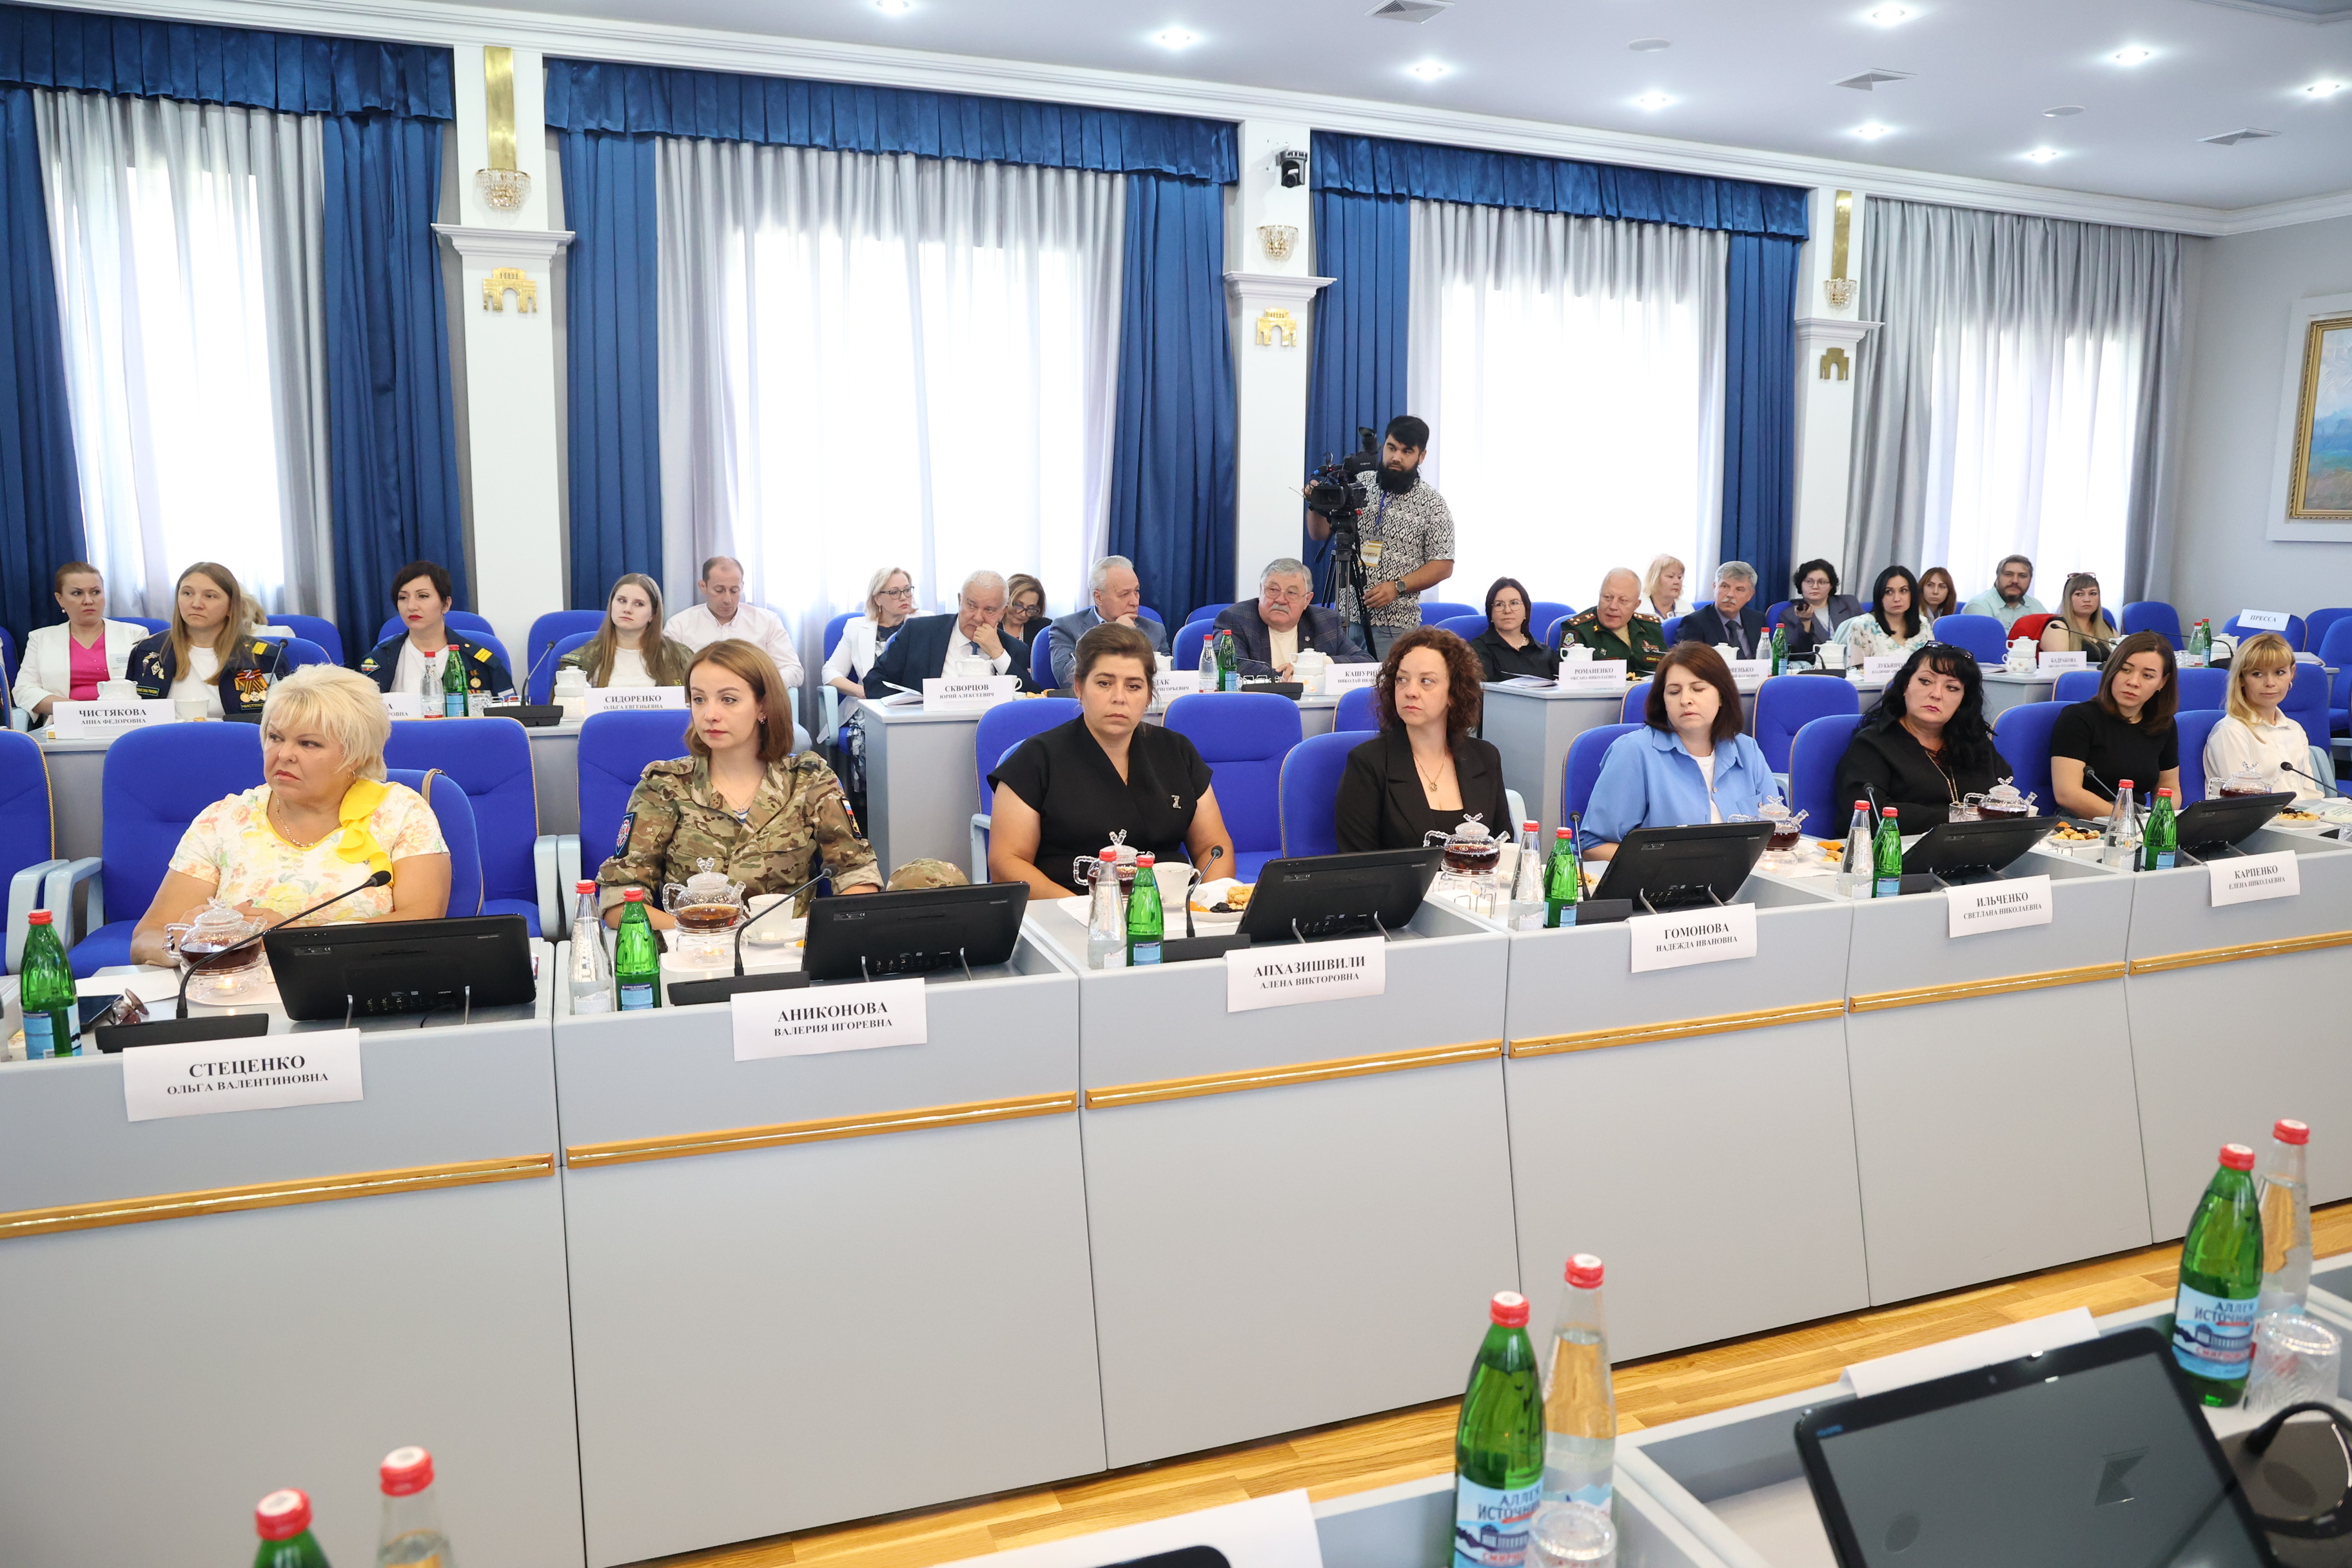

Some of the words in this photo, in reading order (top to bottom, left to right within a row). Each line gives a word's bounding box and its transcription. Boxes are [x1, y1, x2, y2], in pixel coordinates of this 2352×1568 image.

[945, 684, 989, 692] СКВОРЦОВ
[605, 695, 662, 703] СИДОРЕНКО
[79, 709, 147, 717] ЧИСТЯКОВА
[2235, 865, 2278, 879] КАРПЕНКО
[2248, 877, 2286, 887] НИКОЛАЕВНА
[1977, 892, 2028, 907] ИЛЬЧЕНКО
[1963, 910, 1998, 919] СВЕТЛАНА
[1999, 903, 2043, 915] НИКОЛАЕВНА
[1664, 923, 1729, 939] ГОМОНОВА
[1656, 941, 1694, 952] НАДЕЖДА
[1696, 936, 1738, 947] ИВАНОВНА
[1253, 956, 1366, 977] АПХАЗИШВИЛИ
[1260, 980, 1293, 990] АЛЕНА
[1296, 973, 1359, 986] ВИКТОРОВНА
[778, 1001, 888, 1022] АНИКОНОВА
[774, 1024, 828, 1036] ВАЛЕРИЯ
[832, 1019, 893, 1031] ИГОРЕВНА
[189, 1055, 305, 1077] СТЕЦЕНКО
[167, 1083, 214, 1095] ОЛЬГА
[218, 1073, 329, 1090] ВАЛЕНТИНОВНА
